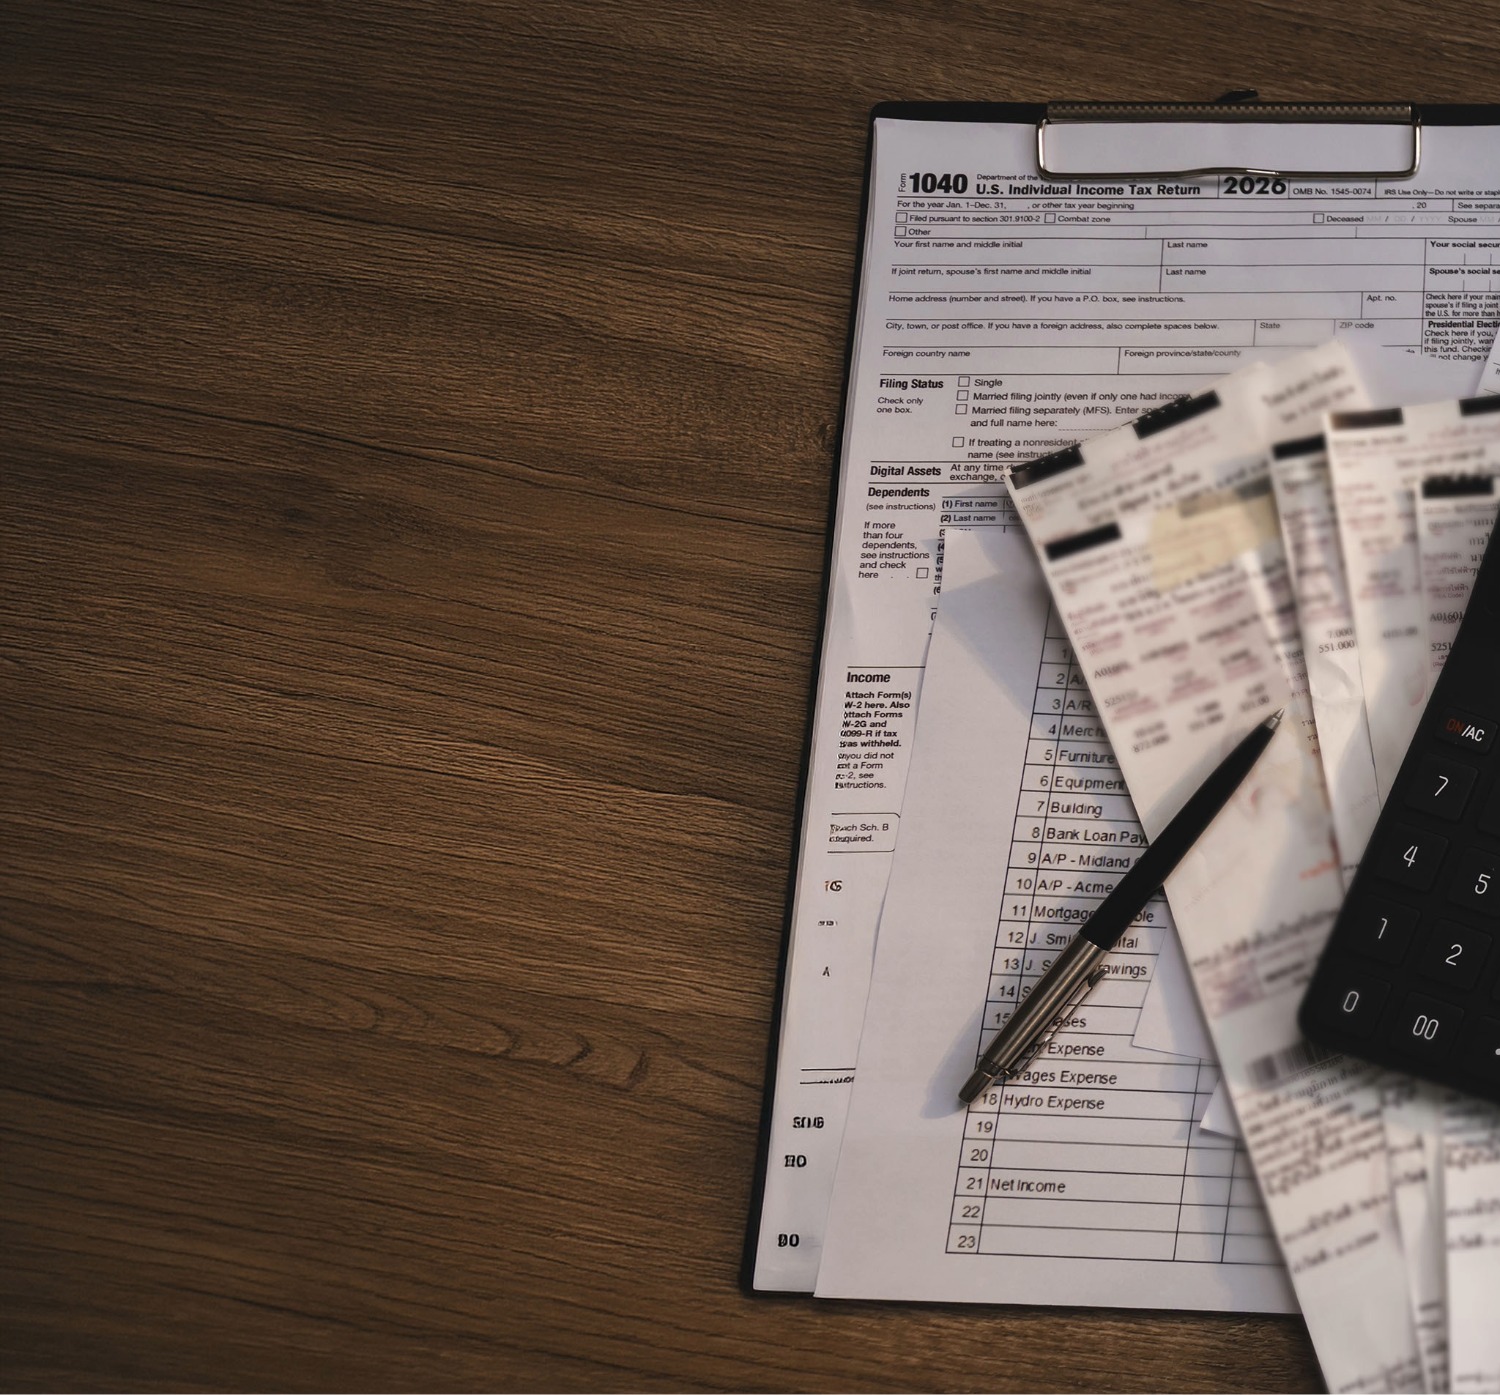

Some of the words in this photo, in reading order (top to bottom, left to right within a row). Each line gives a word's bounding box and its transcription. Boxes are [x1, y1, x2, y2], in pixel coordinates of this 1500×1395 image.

[908, 171, 969, 195] 1040
[976, 183, 1005, 196] U.S.
[1008, 183, 1070, 196] Individual
[1075, 184, 1125, 196] Income
[1128, 184, 1152, 196] Tax
[1156, 184, 1201, 196] Return
[1222, 176, 1287, 196] 2026
[1291, 187, 1314, 196] OMB
[1313, 187, 1329, 196] No.
[1330, 187, 1372, 196] 1545-0074
[893, 239, 914, 248] Your
[914, 239, 931, 248] first
[955, 240, 973, 248] and
[972, 240, 1001, 249] middle
[1001, 240, 1024, 248] initial
[1166, 240, 1185, 249] Last
[1185, 241, 1209, 249] name
[882, 348, 914, 359] Foreign
[914, 349, 947, 359] country
[947, 350, 971, 358] name
[878, 377, 909, 391] Filing
[910, 377, 944, 389] Status
[973, 377, 1003, 389] Single
[971, 405, 1008, 415] Married
[1008, 405, 1032, 417] filing
[1032, 405, 1081, 417] separately
[1082, 405, 1112, 416] (MFS).
[869, 464, 905, 478] Digital
[905, 465, 942, 477] Assets
[866, 486, 931, 499] Dependents
[865, 502, 885, 512] (see
[884, 502, 937, 512] instructions)
[845, 671, 891, 684] Income
[1433, 774, 1449, 797] 7
[1036, 799, 1046, 812] 7
[1049, 800, 1104, 819] Building
[1045, 826, 1080, 841] Bank
[1402, 844, 1419, 868] 4
[1474, 872, 1492, 895] 5
[1007, 930, 1025, 945] 12
[1411, 1014, 1440, 1041] 00
[1003, 1093, 1044, 1110] Hydro
[1046, 1094, 1105, 1112] Expense
[965, 1176, 984, 1190] 21
[956, 1234, 976, 1249] 23
